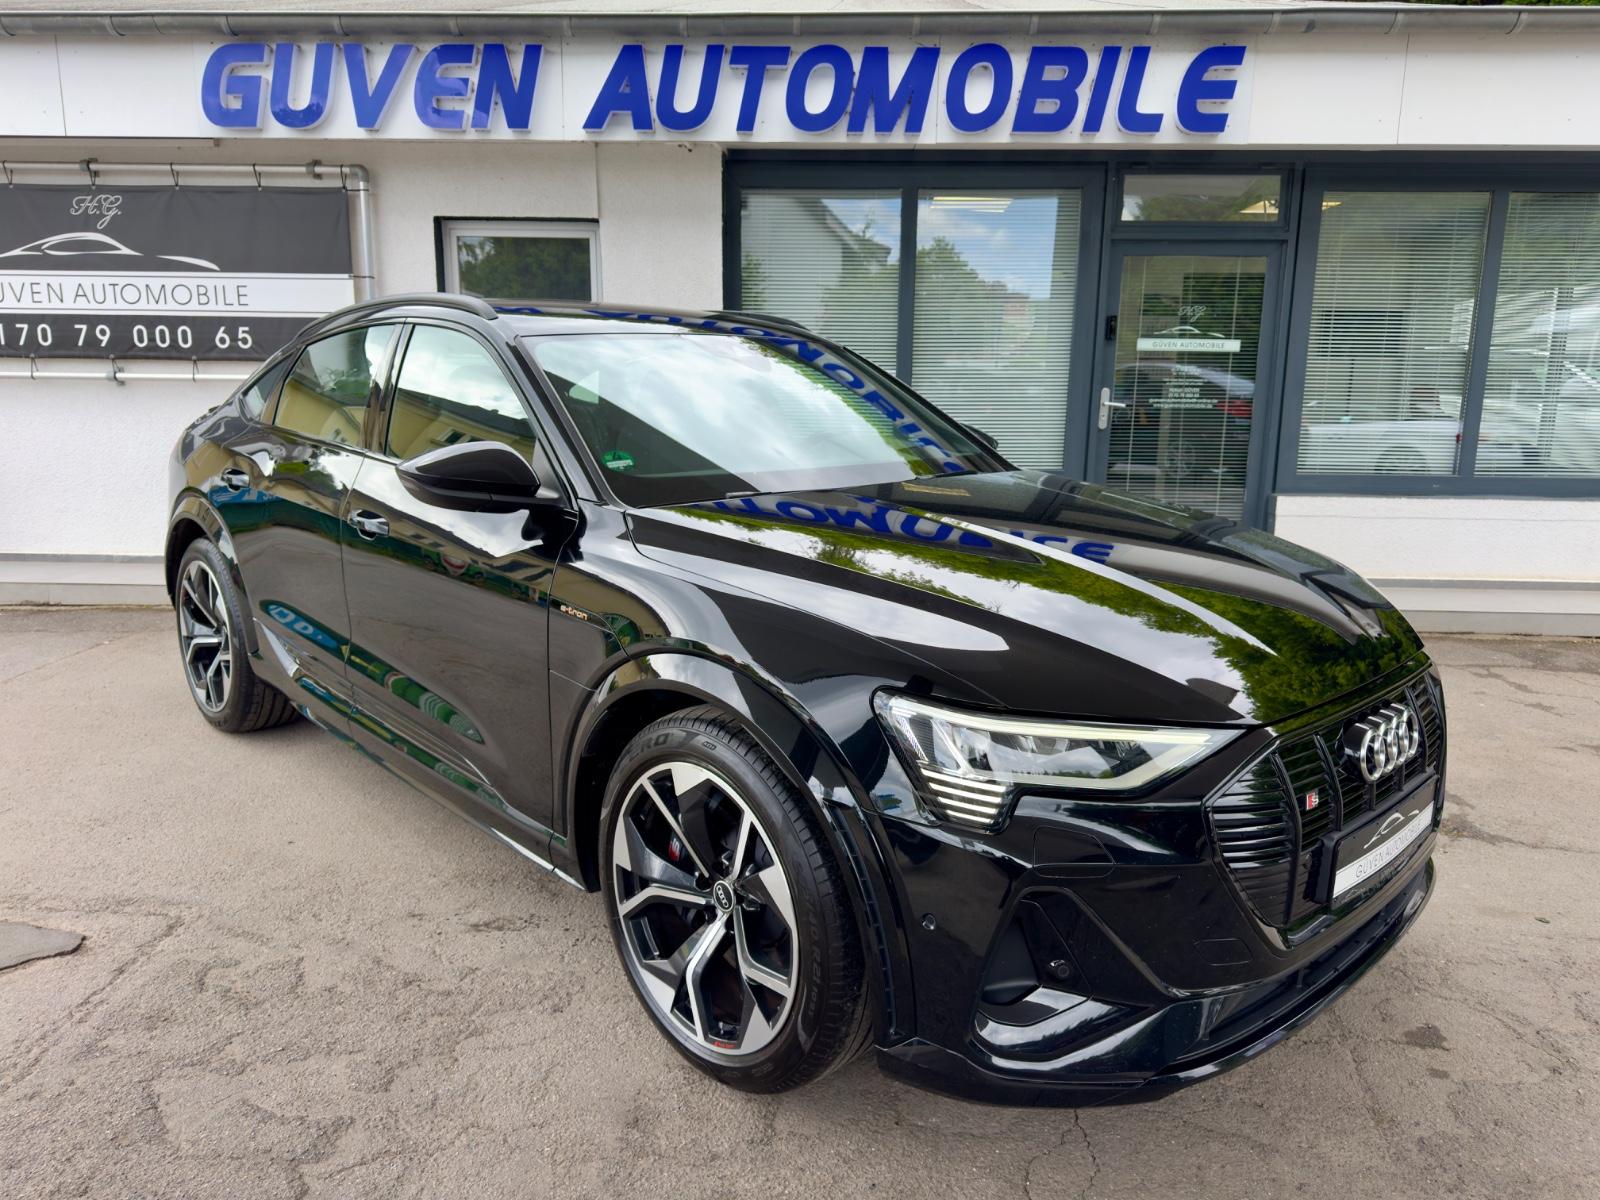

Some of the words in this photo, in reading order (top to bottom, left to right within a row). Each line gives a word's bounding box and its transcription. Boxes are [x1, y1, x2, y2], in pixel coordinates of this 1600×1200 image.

[201, 43, 544, 132] GUVEN
[582, 43, 1247, 136] AUTOMOBILE
[0, 282, 64, 304] VEN
[73, 282, 250, 307] AUTOMOBILE
[73, 324, 111, 348] 79
[133, 324, 193, 348] 000
[214, 325, 253, 350] 65
[1179, 341, 1225, 349] AUTOMOBILE
[560, 605, 588, 621] e-tron
